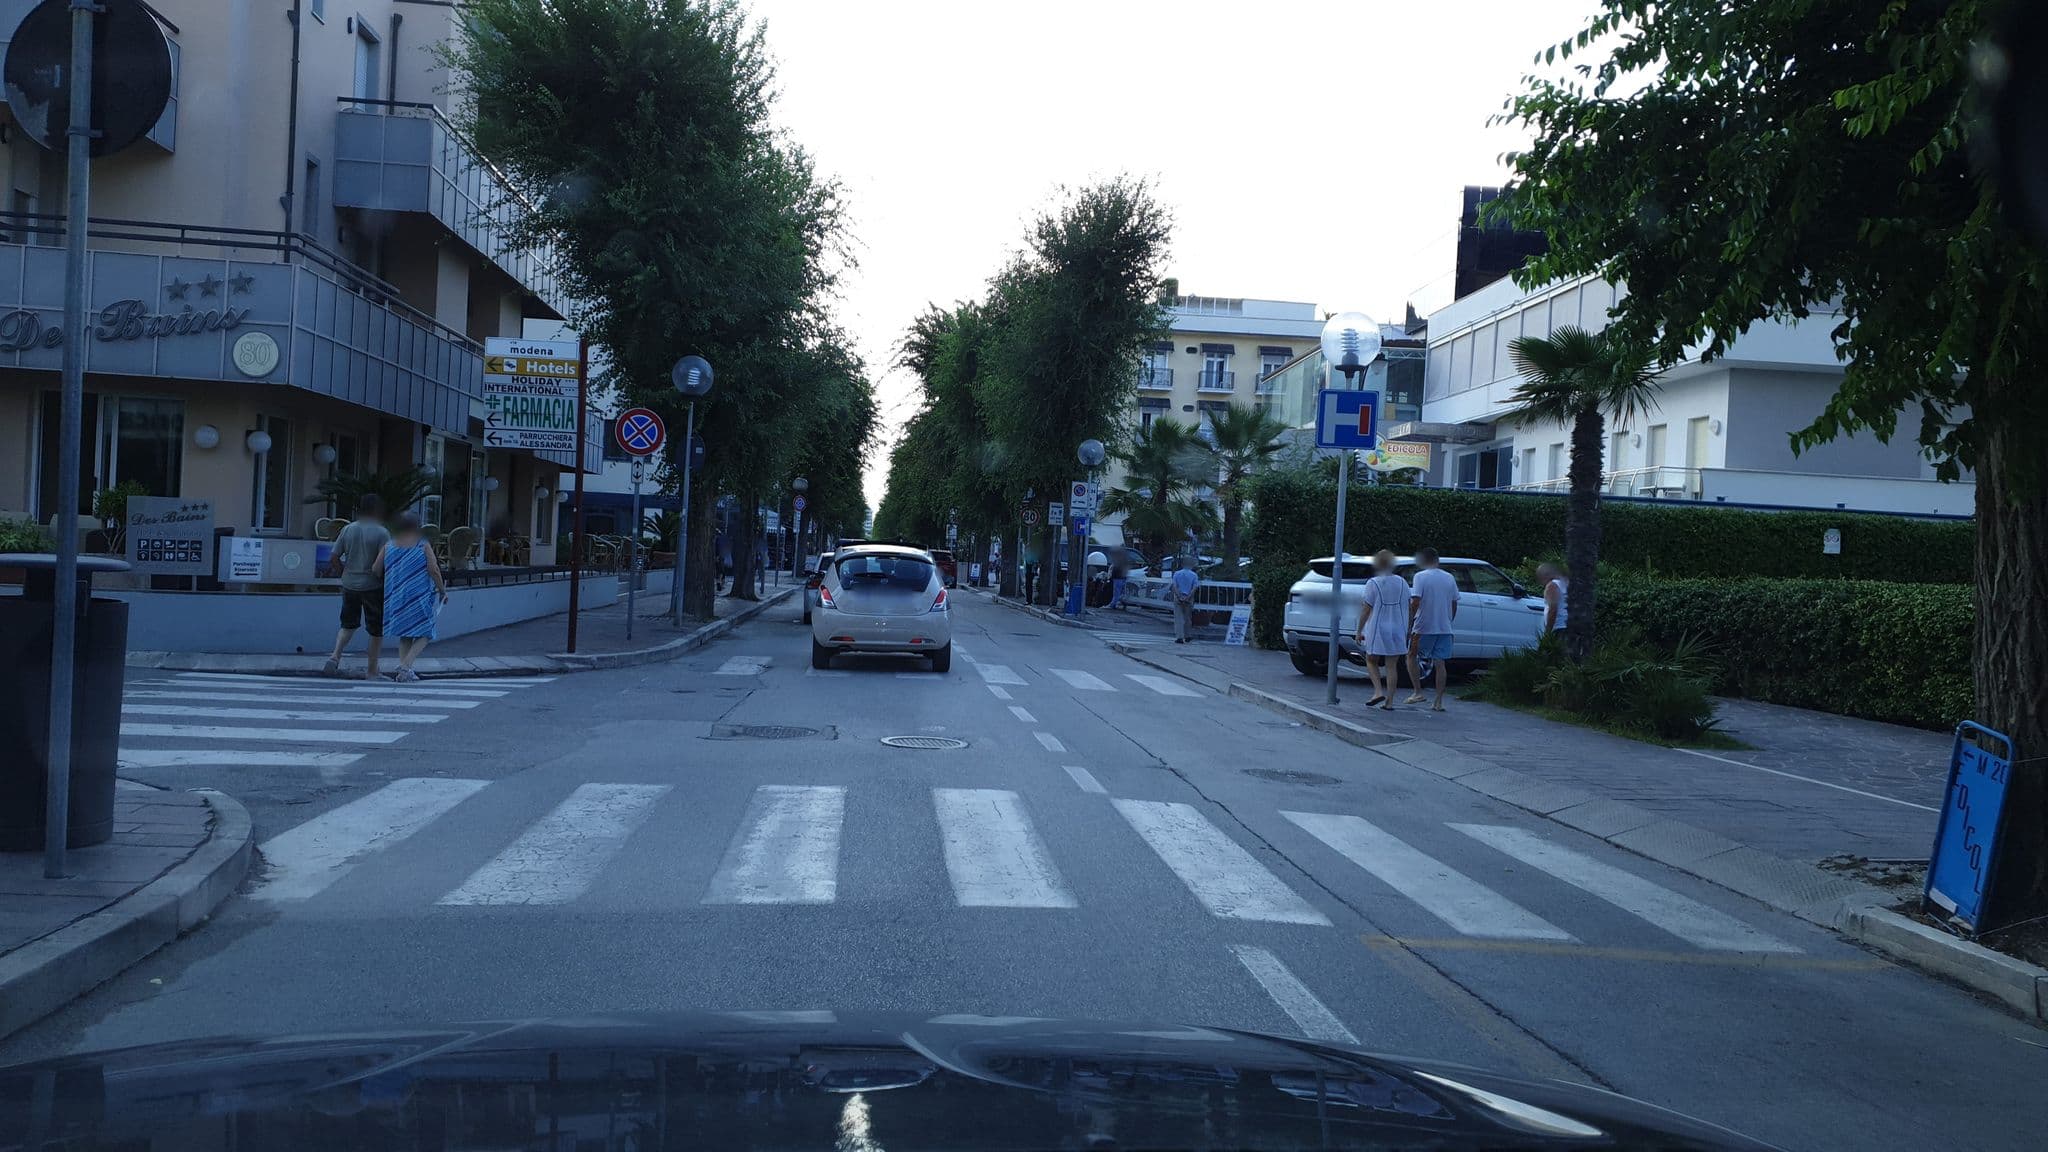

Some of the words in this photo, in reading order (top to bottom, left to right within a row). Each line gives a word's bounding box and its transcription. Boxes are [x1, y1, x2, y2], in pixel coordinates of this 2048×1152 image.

[0, 310, 91, 351] De
[95, 299, 251, 342] Bains
[240, 341, 271, 366] 80
[510, 346, 554, 356] modena
[526, 361, 576, 375] Hotels
[511, 376, 562, 386] HOLIDAY
[484, 384, 565, 396] INTERNATIONAL
[503, 395, 575, 430] FARMACIA
[520, 432, 573, 442] PARRUCCHIERA
[520, 440, 573, 450] ALESSANDRA
[1387, 443, 1427, 455] EDICOLA
[131, 512, 158, 526] Des
[161, 511, 207, 524] Bains
[1976, 753, 1989, 776] M
